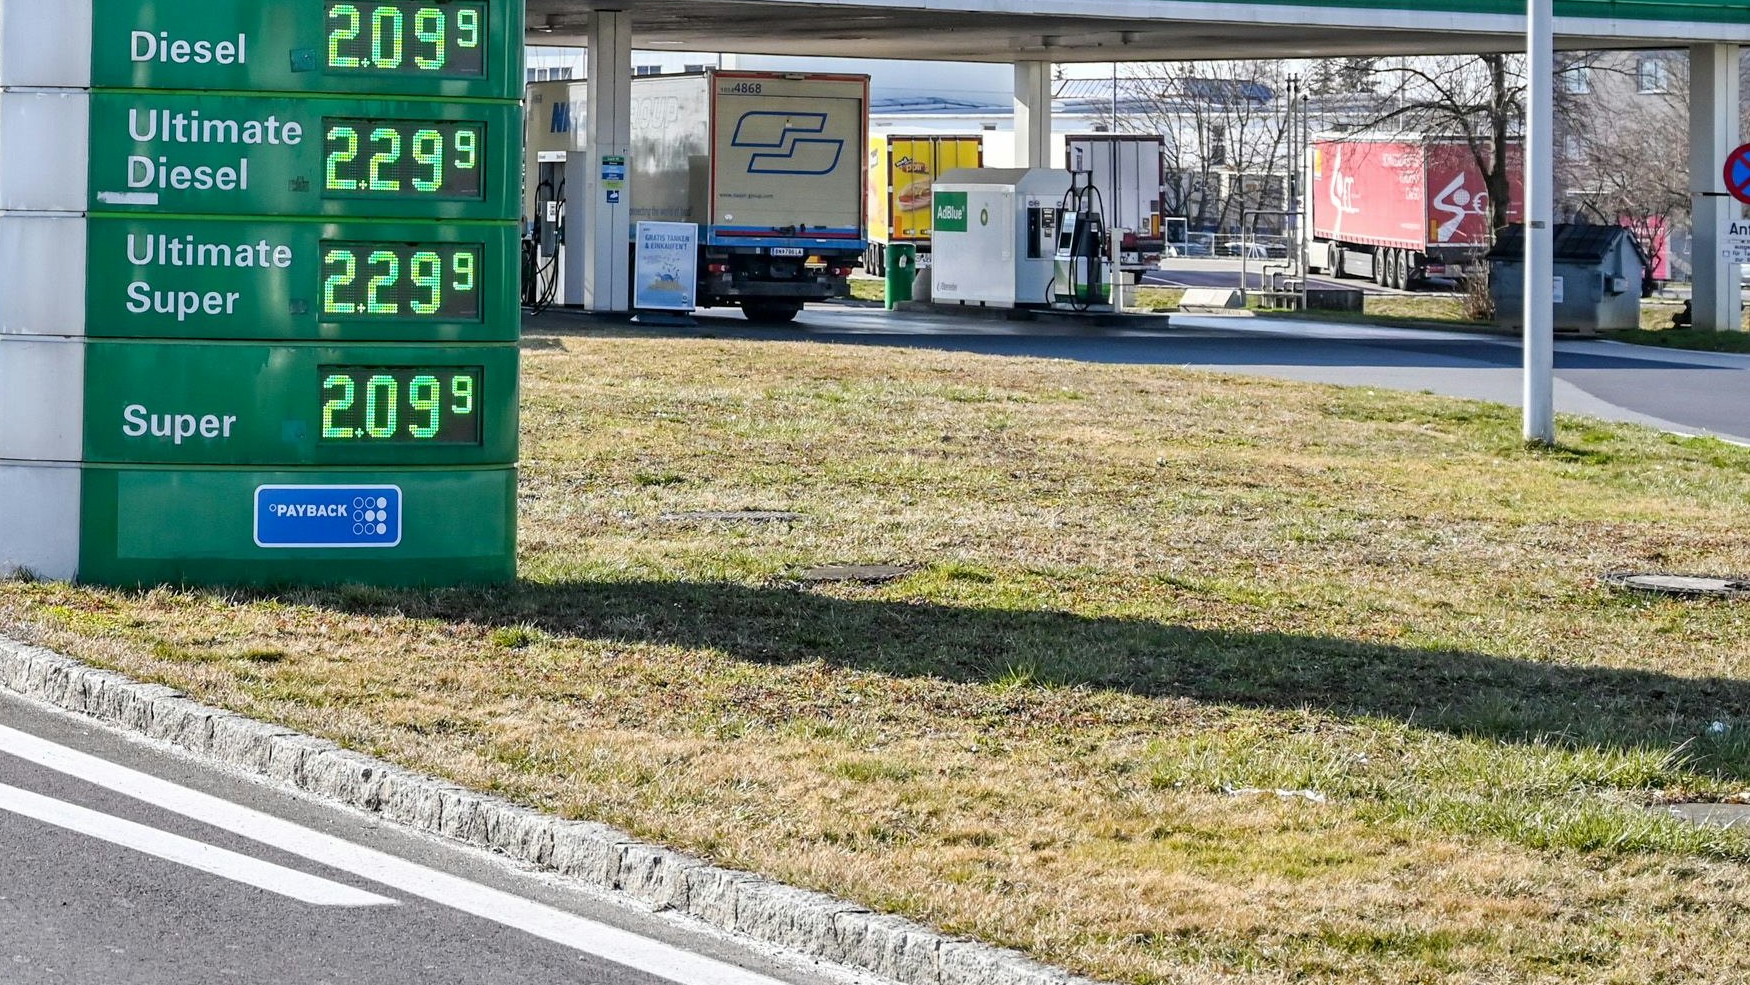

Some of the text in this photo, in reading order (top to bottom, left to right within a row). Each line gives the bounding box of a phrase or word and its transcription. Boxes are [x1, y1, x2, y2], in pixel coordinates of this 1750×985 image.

[130, 29, 246, 65] Diesel
[128, 108, 302, 146] Ultimate
[127, 155, 248, 190] Diesel
[126, 234, 292, 267] Ultimate
[644, 233, 690, 243] GRATIS TANKEN
[125, 281, 239, 321] Super
[122, 403, 237, 444] Super
[277, 503, 348, 518] PAYBACK
